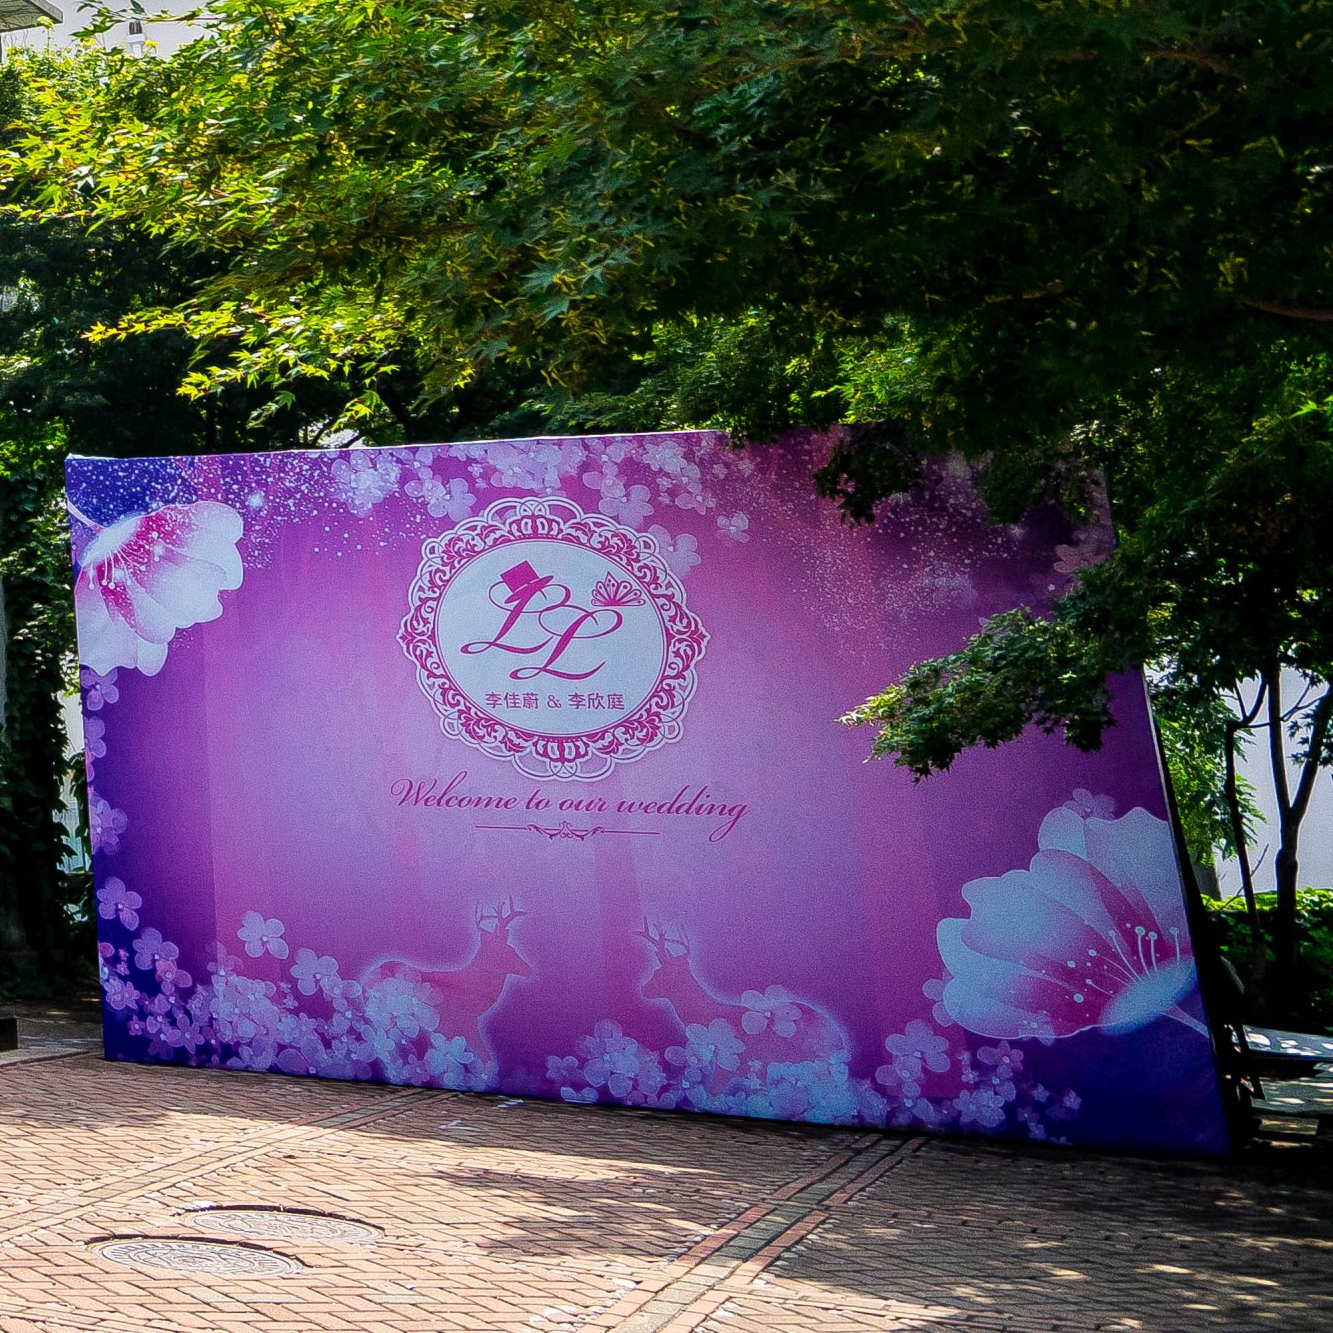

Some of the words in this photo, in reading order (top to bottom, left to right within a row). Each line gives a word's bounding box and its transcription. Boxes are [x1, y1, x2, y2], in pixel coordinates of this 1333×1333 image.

[485, 691, 539, 710] 李佳蔚
[547, 695, 562, 708] &
[568, 692, 625, 711] 李欣庭
[390, 770, 519, 811] Welcome
[526, 788, 551, 811] to
[557, 797, 606, 814] our
[616, 784, 750, 843] wedding
